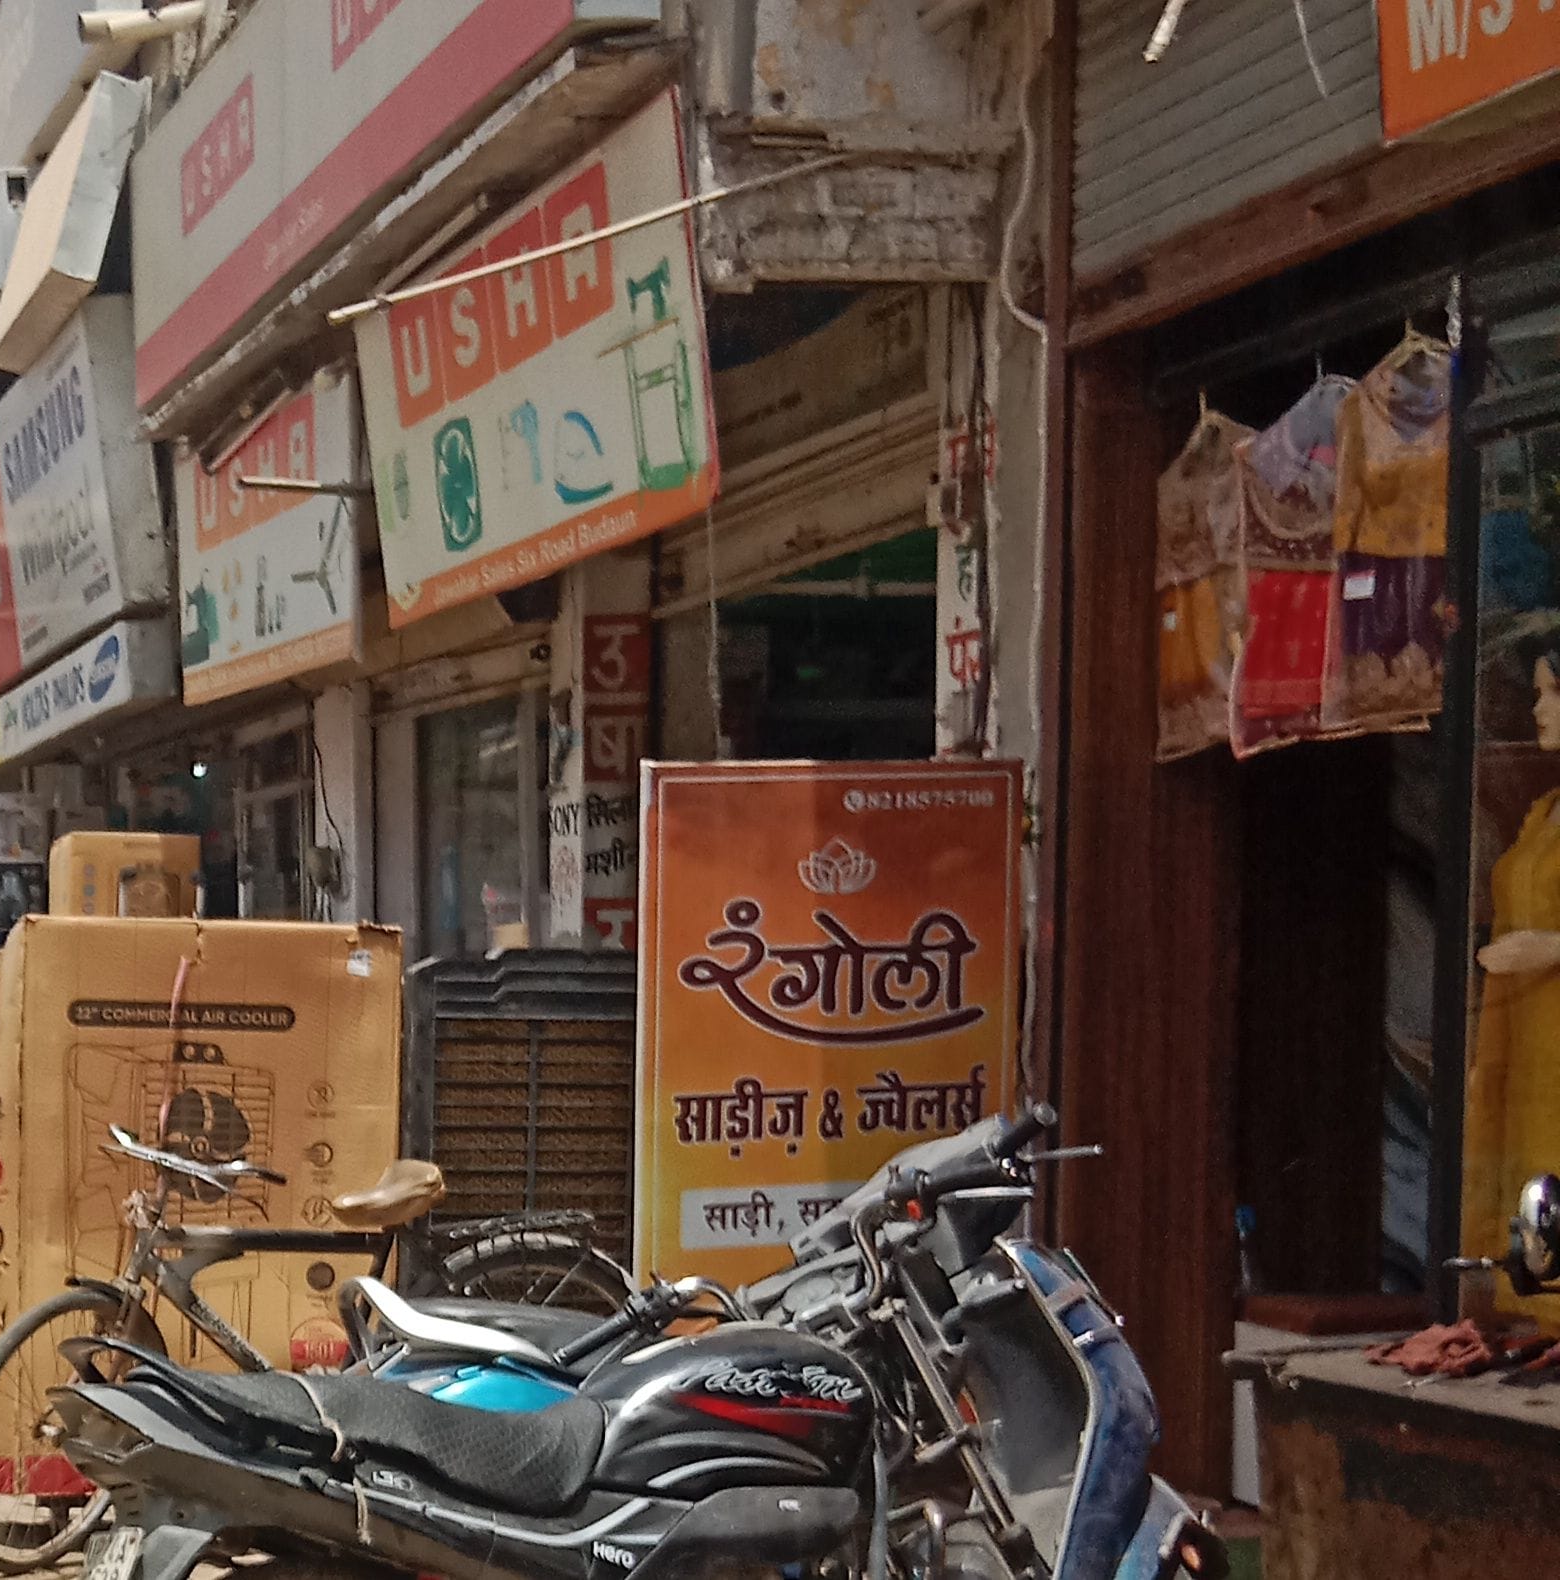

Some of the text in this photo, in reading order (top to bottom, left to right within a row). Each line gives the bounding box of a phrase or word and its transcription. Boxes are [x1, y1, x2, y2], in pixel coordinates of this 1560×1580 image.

[399, 203, 598, 399] USHA
[3, 366, 85, 506] SAMSUNG
[200, 419, 309, 532] USHA
[101, 1007, 199, 1025] COMMERCAL
[200, 1009, 225, 1024] AIR
[228, 1009, 289, 1027] COOLER
[679, 898, 985, 1047] रंगोली
[673, 1075, 810, 1159] साड़ीज़
[817, 1086, 845, 1140] &
[703, 1189, 785, 1238] साड़ी,
[592, 1540, 637, 1571] Hero
